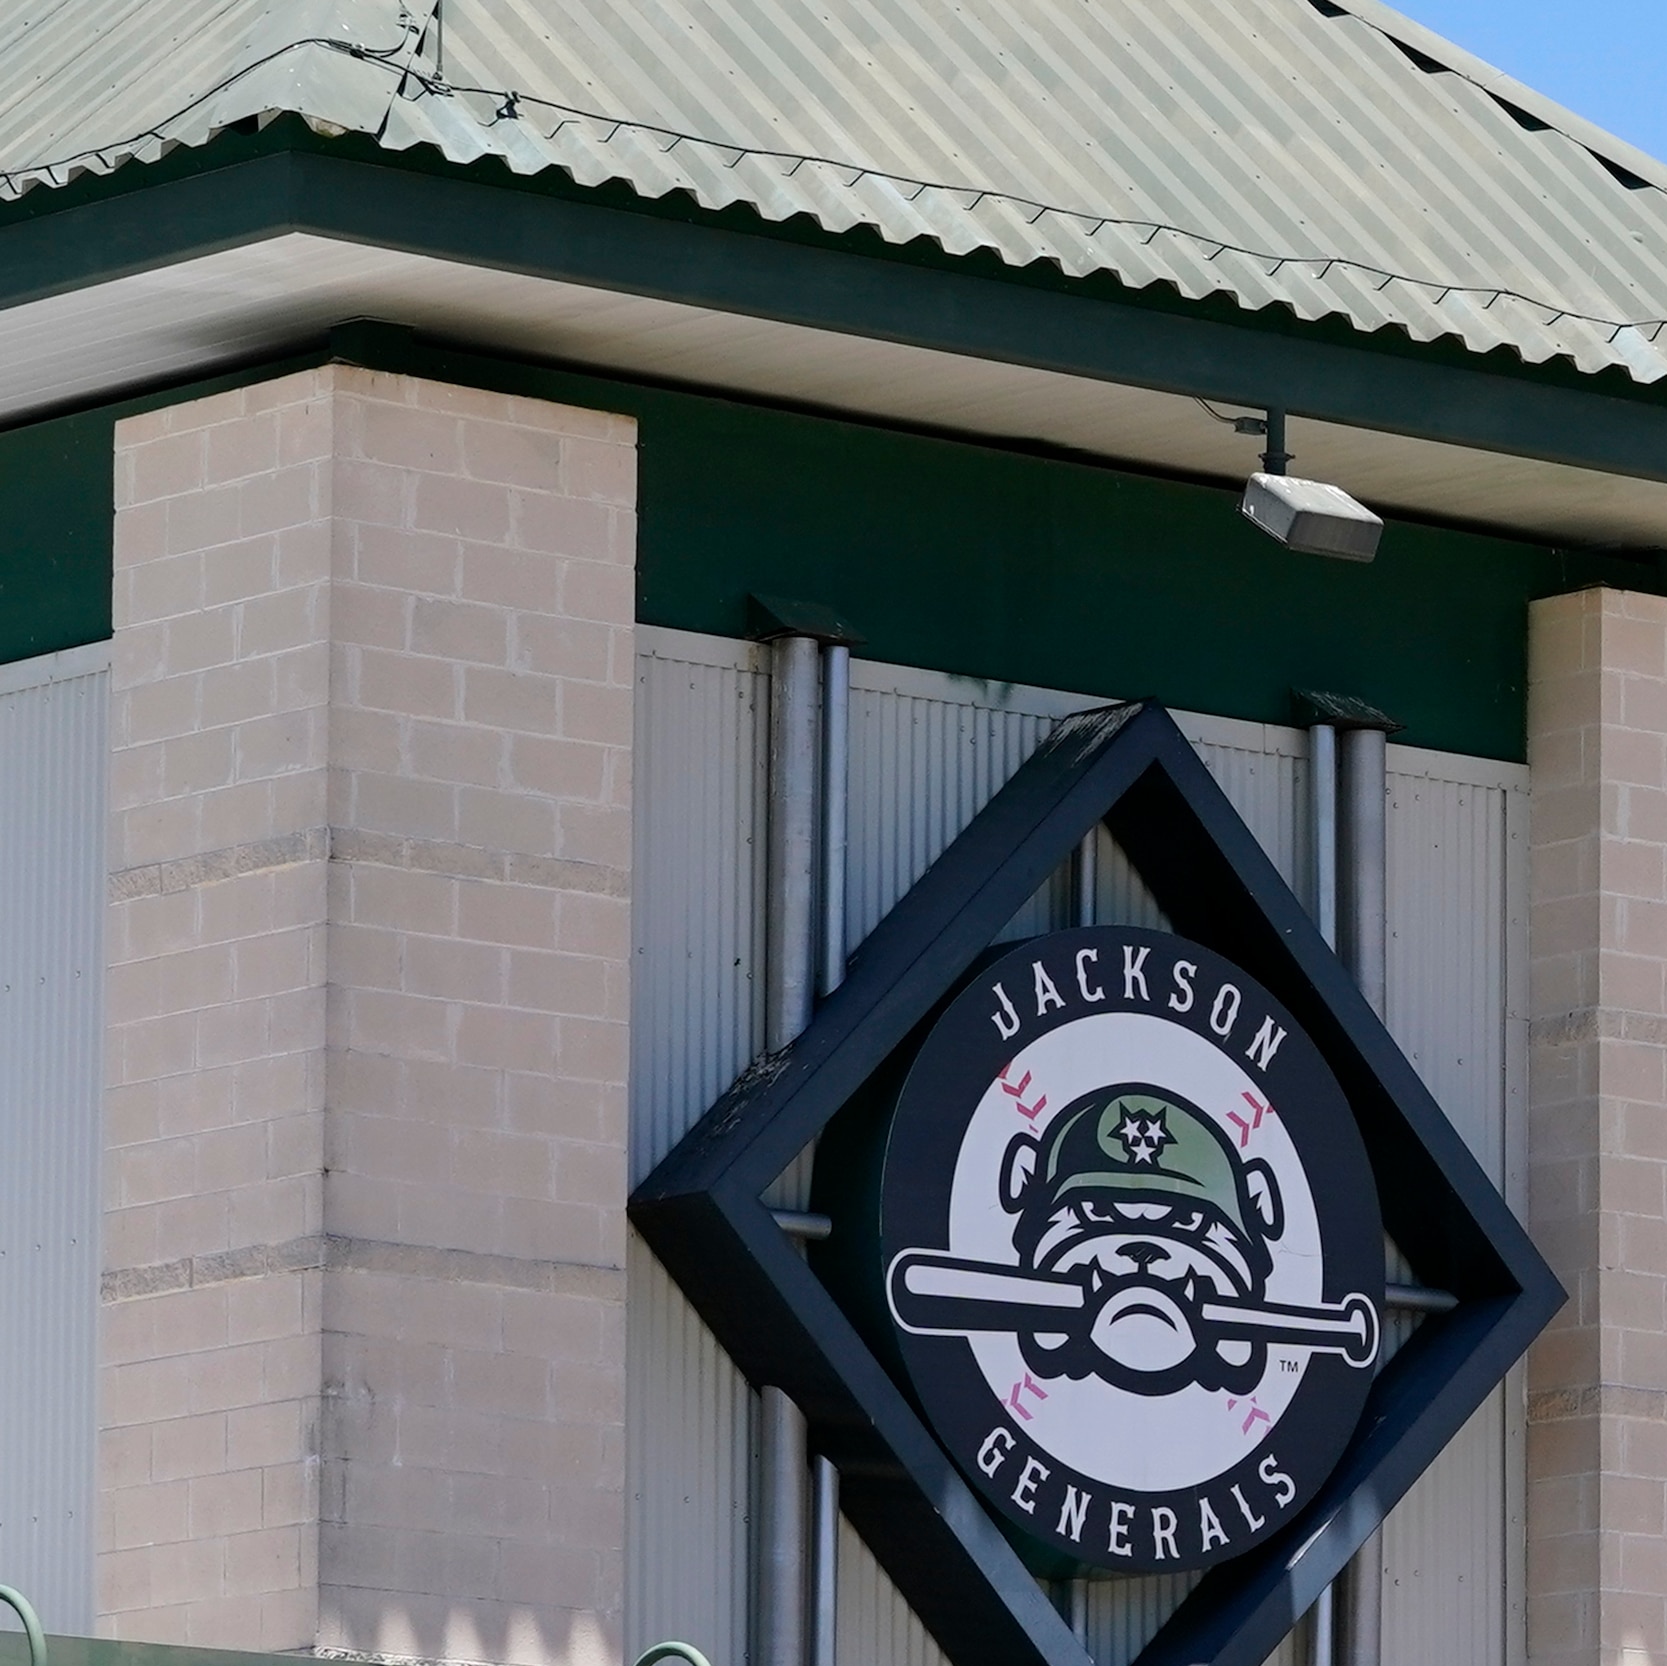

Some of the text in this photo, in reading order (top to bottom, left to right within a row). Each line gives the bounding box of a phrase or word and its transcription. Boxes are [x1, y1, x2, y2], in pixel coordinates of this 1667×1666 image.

[991, 945, 1288, 1071] JACKSON
[1279, 1360, 1299, 1373] TM
[976, 1427, 1297, 1560] GENERALS
